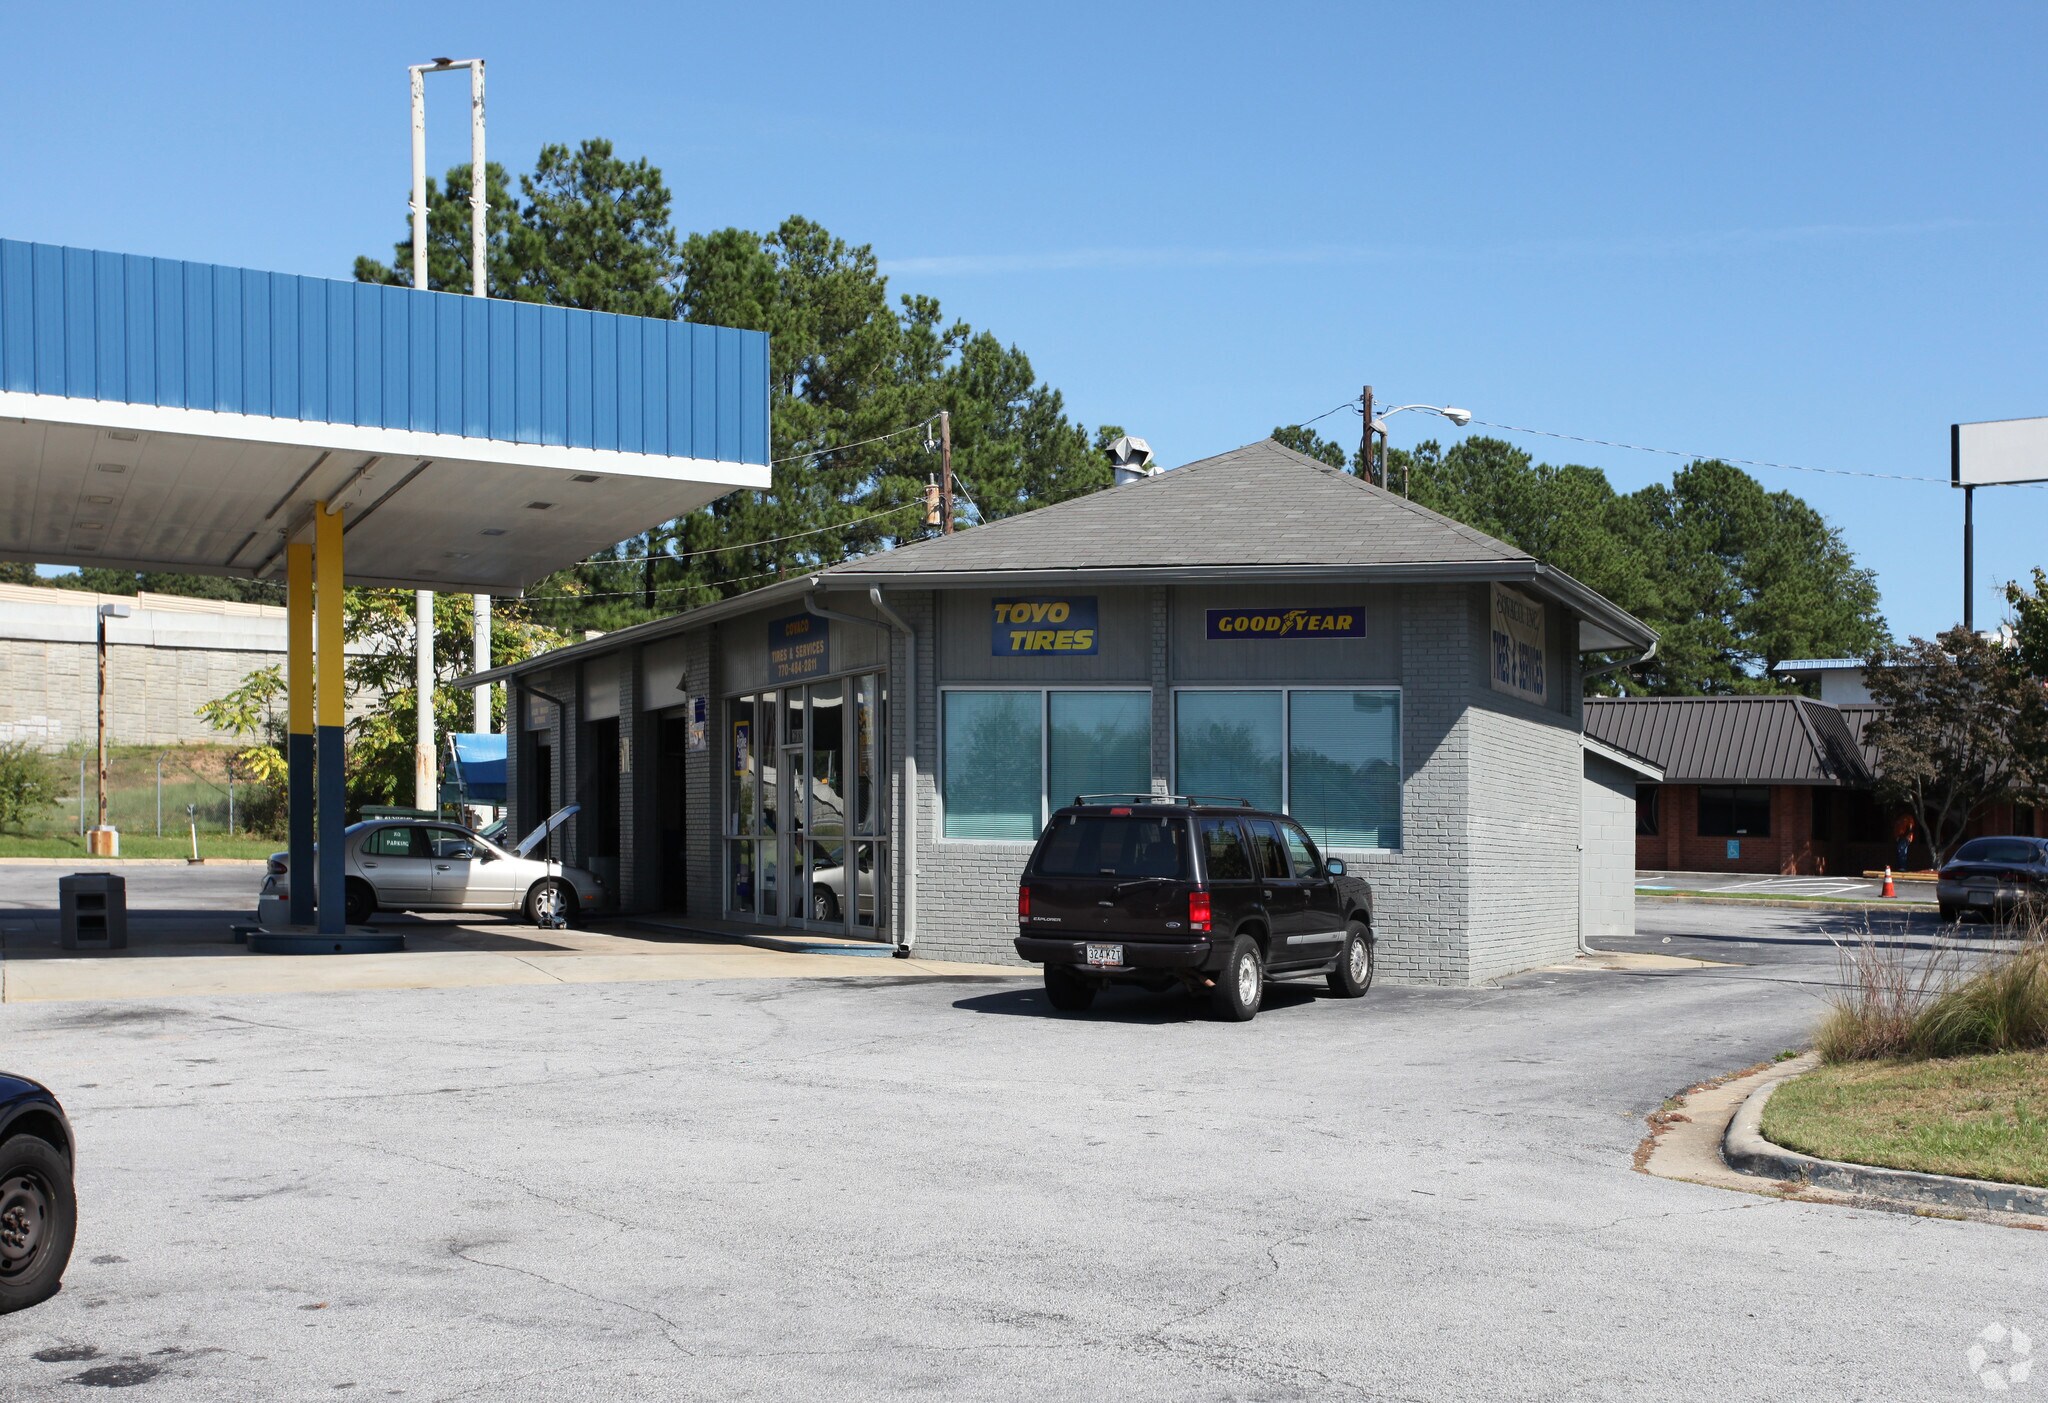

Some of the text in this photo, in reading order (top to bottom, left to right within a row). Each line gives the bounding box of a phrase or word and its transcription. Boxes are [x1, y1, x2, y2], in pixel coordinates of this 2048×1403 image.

[994, 602, 1070, 624] TOYO
[1218, 612, 1353, 633] GOODYEAR
[1009, 629, 1094, 651] TIRES
[771, 640, 824, 663] TIRES & SERVICES
[386, 839, 409, 847] PARKING
